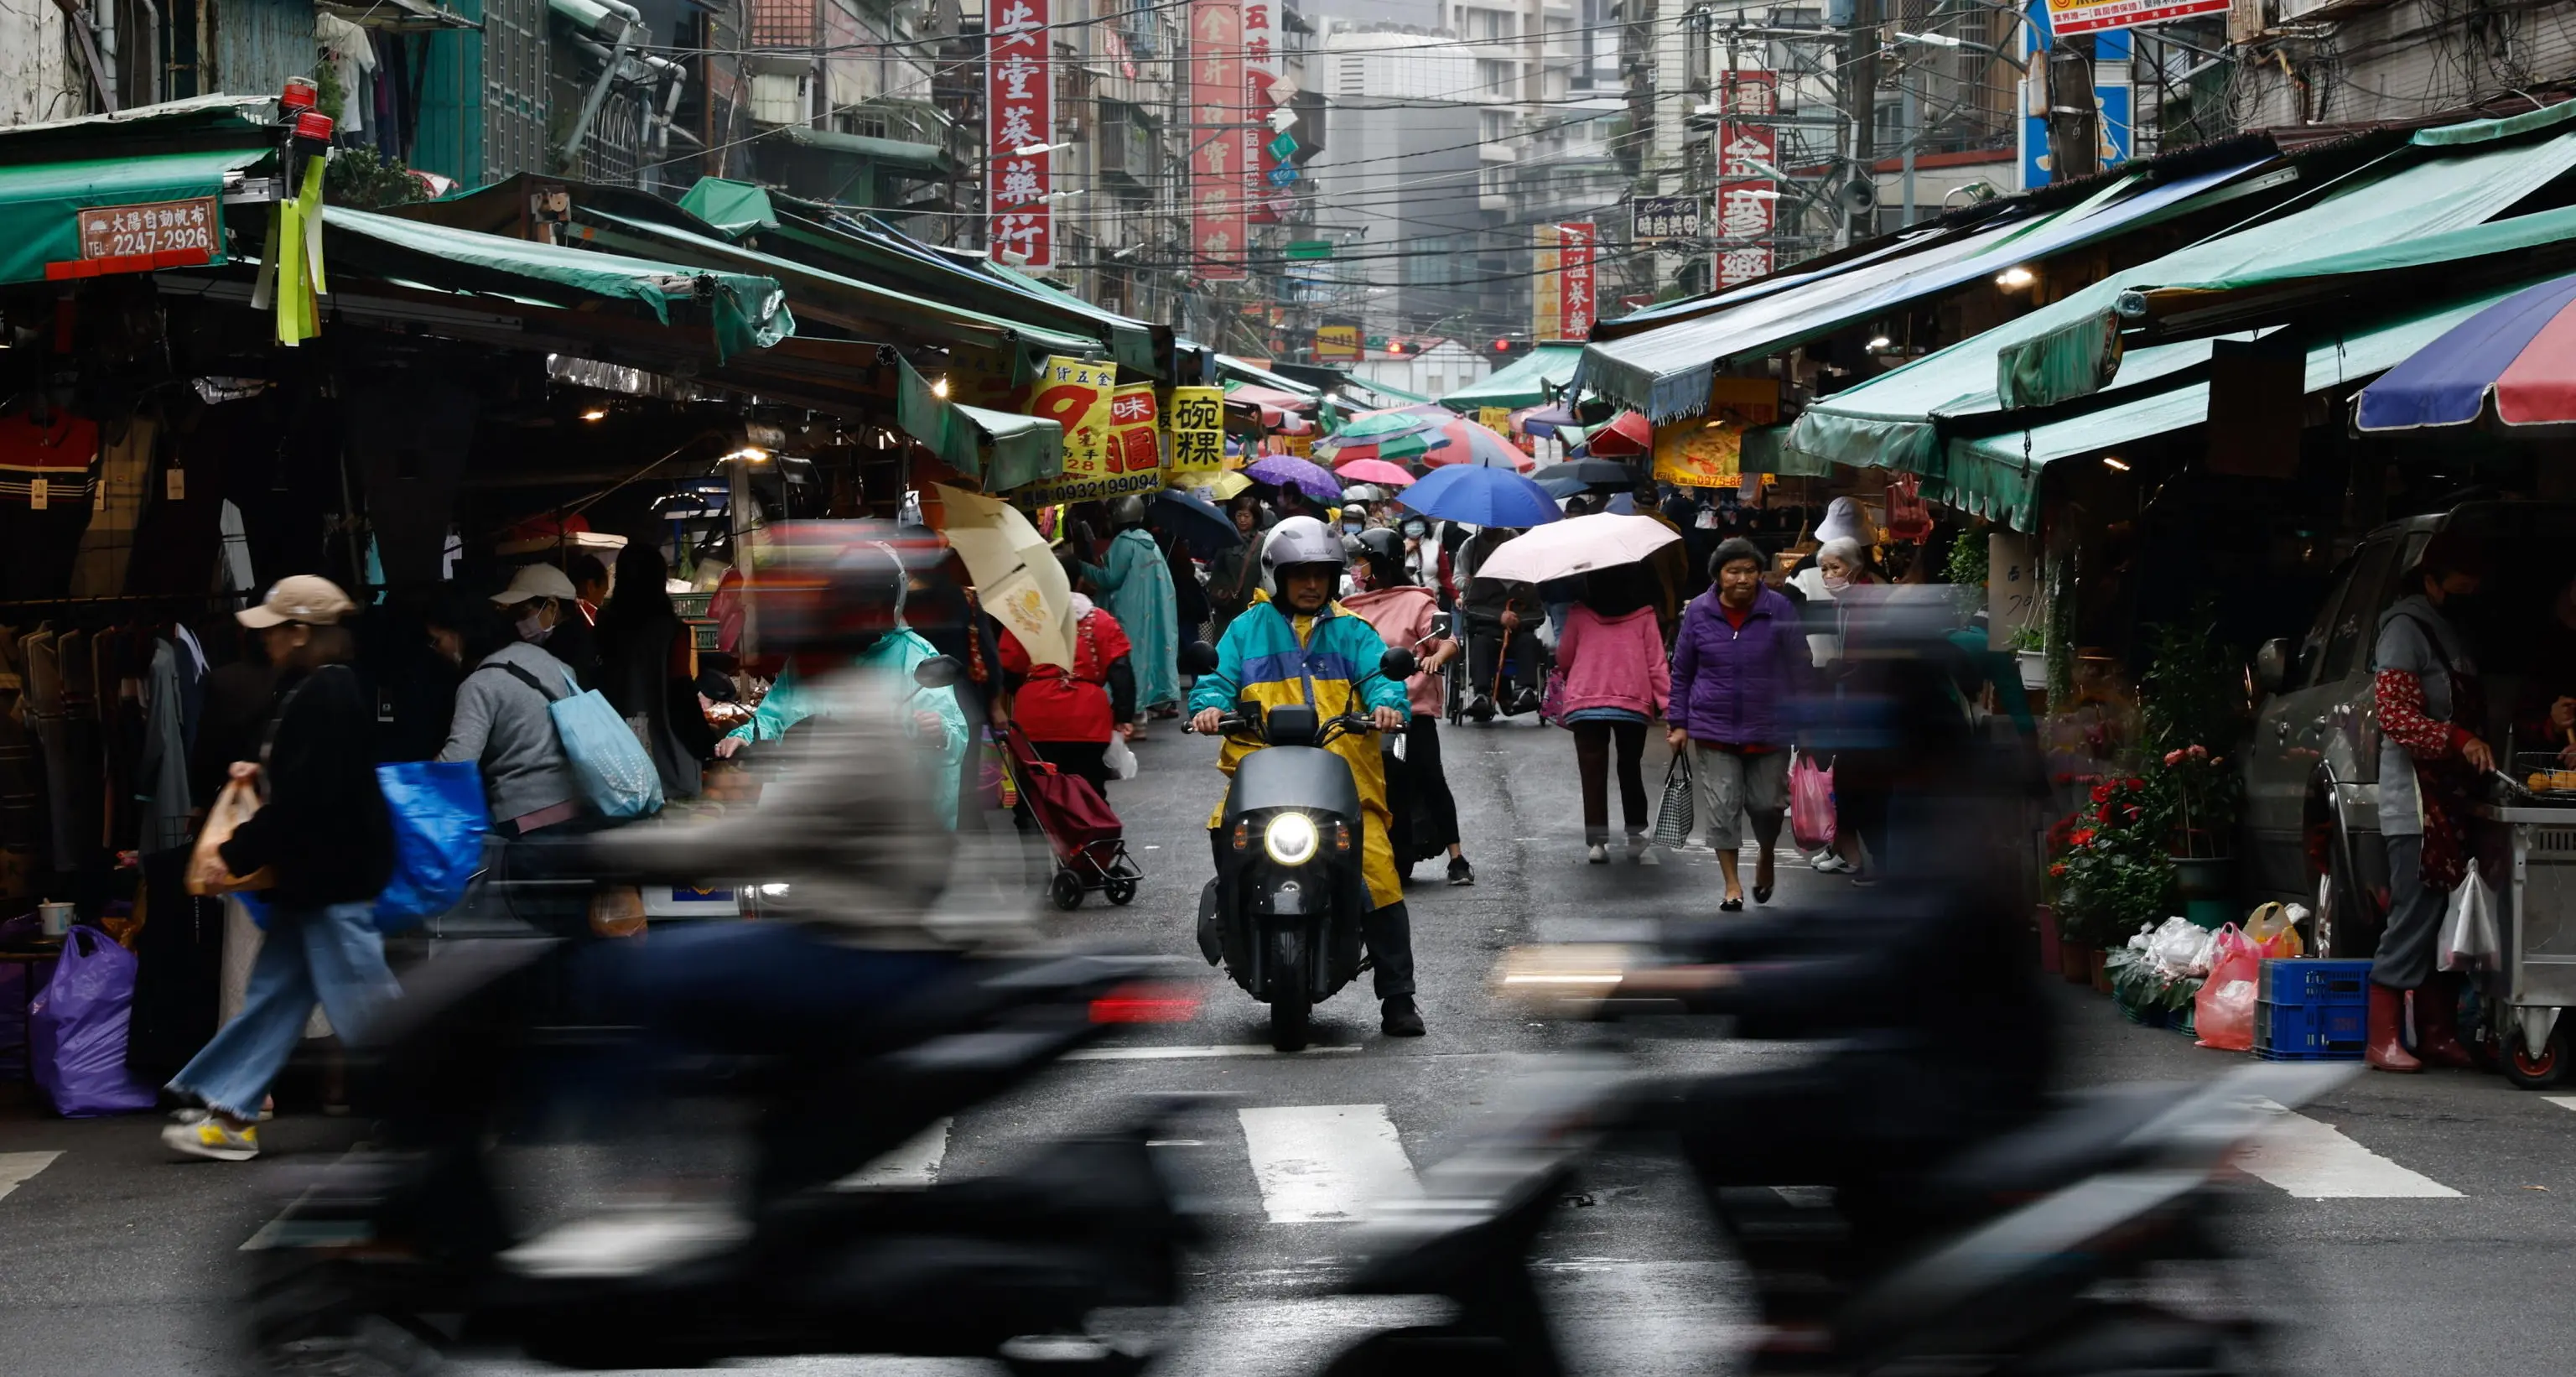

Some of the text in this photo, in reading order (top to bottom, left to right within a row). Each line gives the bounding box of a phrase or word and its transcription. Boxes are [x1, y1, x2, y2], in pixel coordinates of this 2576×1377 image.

[1638, 216, 1697, 236] 時尚美甲
[114, 227, 208, 256] 2247-2926
[1041, 366, 1112, 386] 貨五金
[1176, 397, 1218, 465] 碗粿
